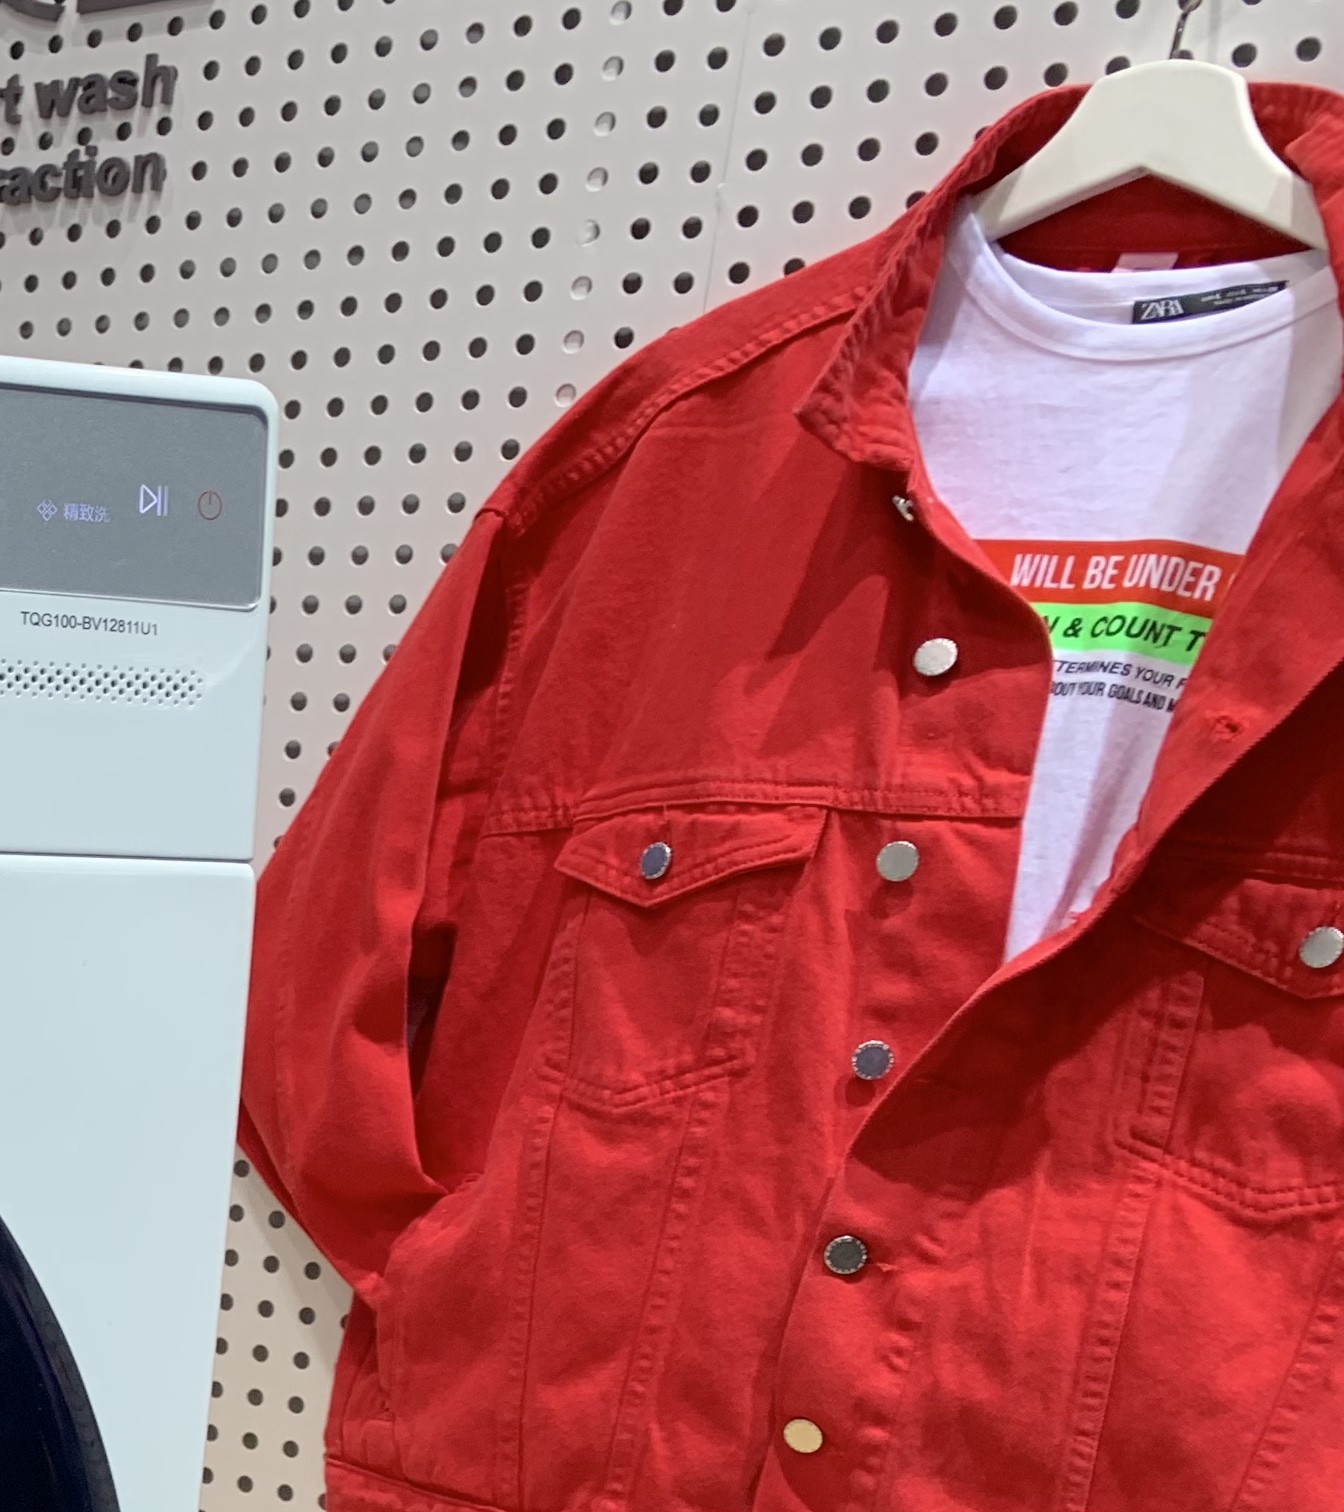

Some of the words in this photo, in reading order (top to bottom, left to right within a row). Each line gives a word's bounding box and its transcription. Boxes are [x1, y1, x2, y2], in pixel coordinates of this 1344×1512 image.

[33, 53, 178, 119] wash
[1140, 299, 1184, 321] ZARA
[63, 502, 110, 523] 精致洗
[1010, 553, 1076, 590] WILL
[1082, 555, 1125, 590] BE
[1122, 553, 1222, 601] UNDER
[20, 610, 159, 636] TQG100-BV12811U1
[1062, 617, 1083, 638] &
[1090, 614, 1183, 648] COUNT
[1054, 660, 1132, 676] TERMINES
[1135, 666, 1175, 688] YOUR
